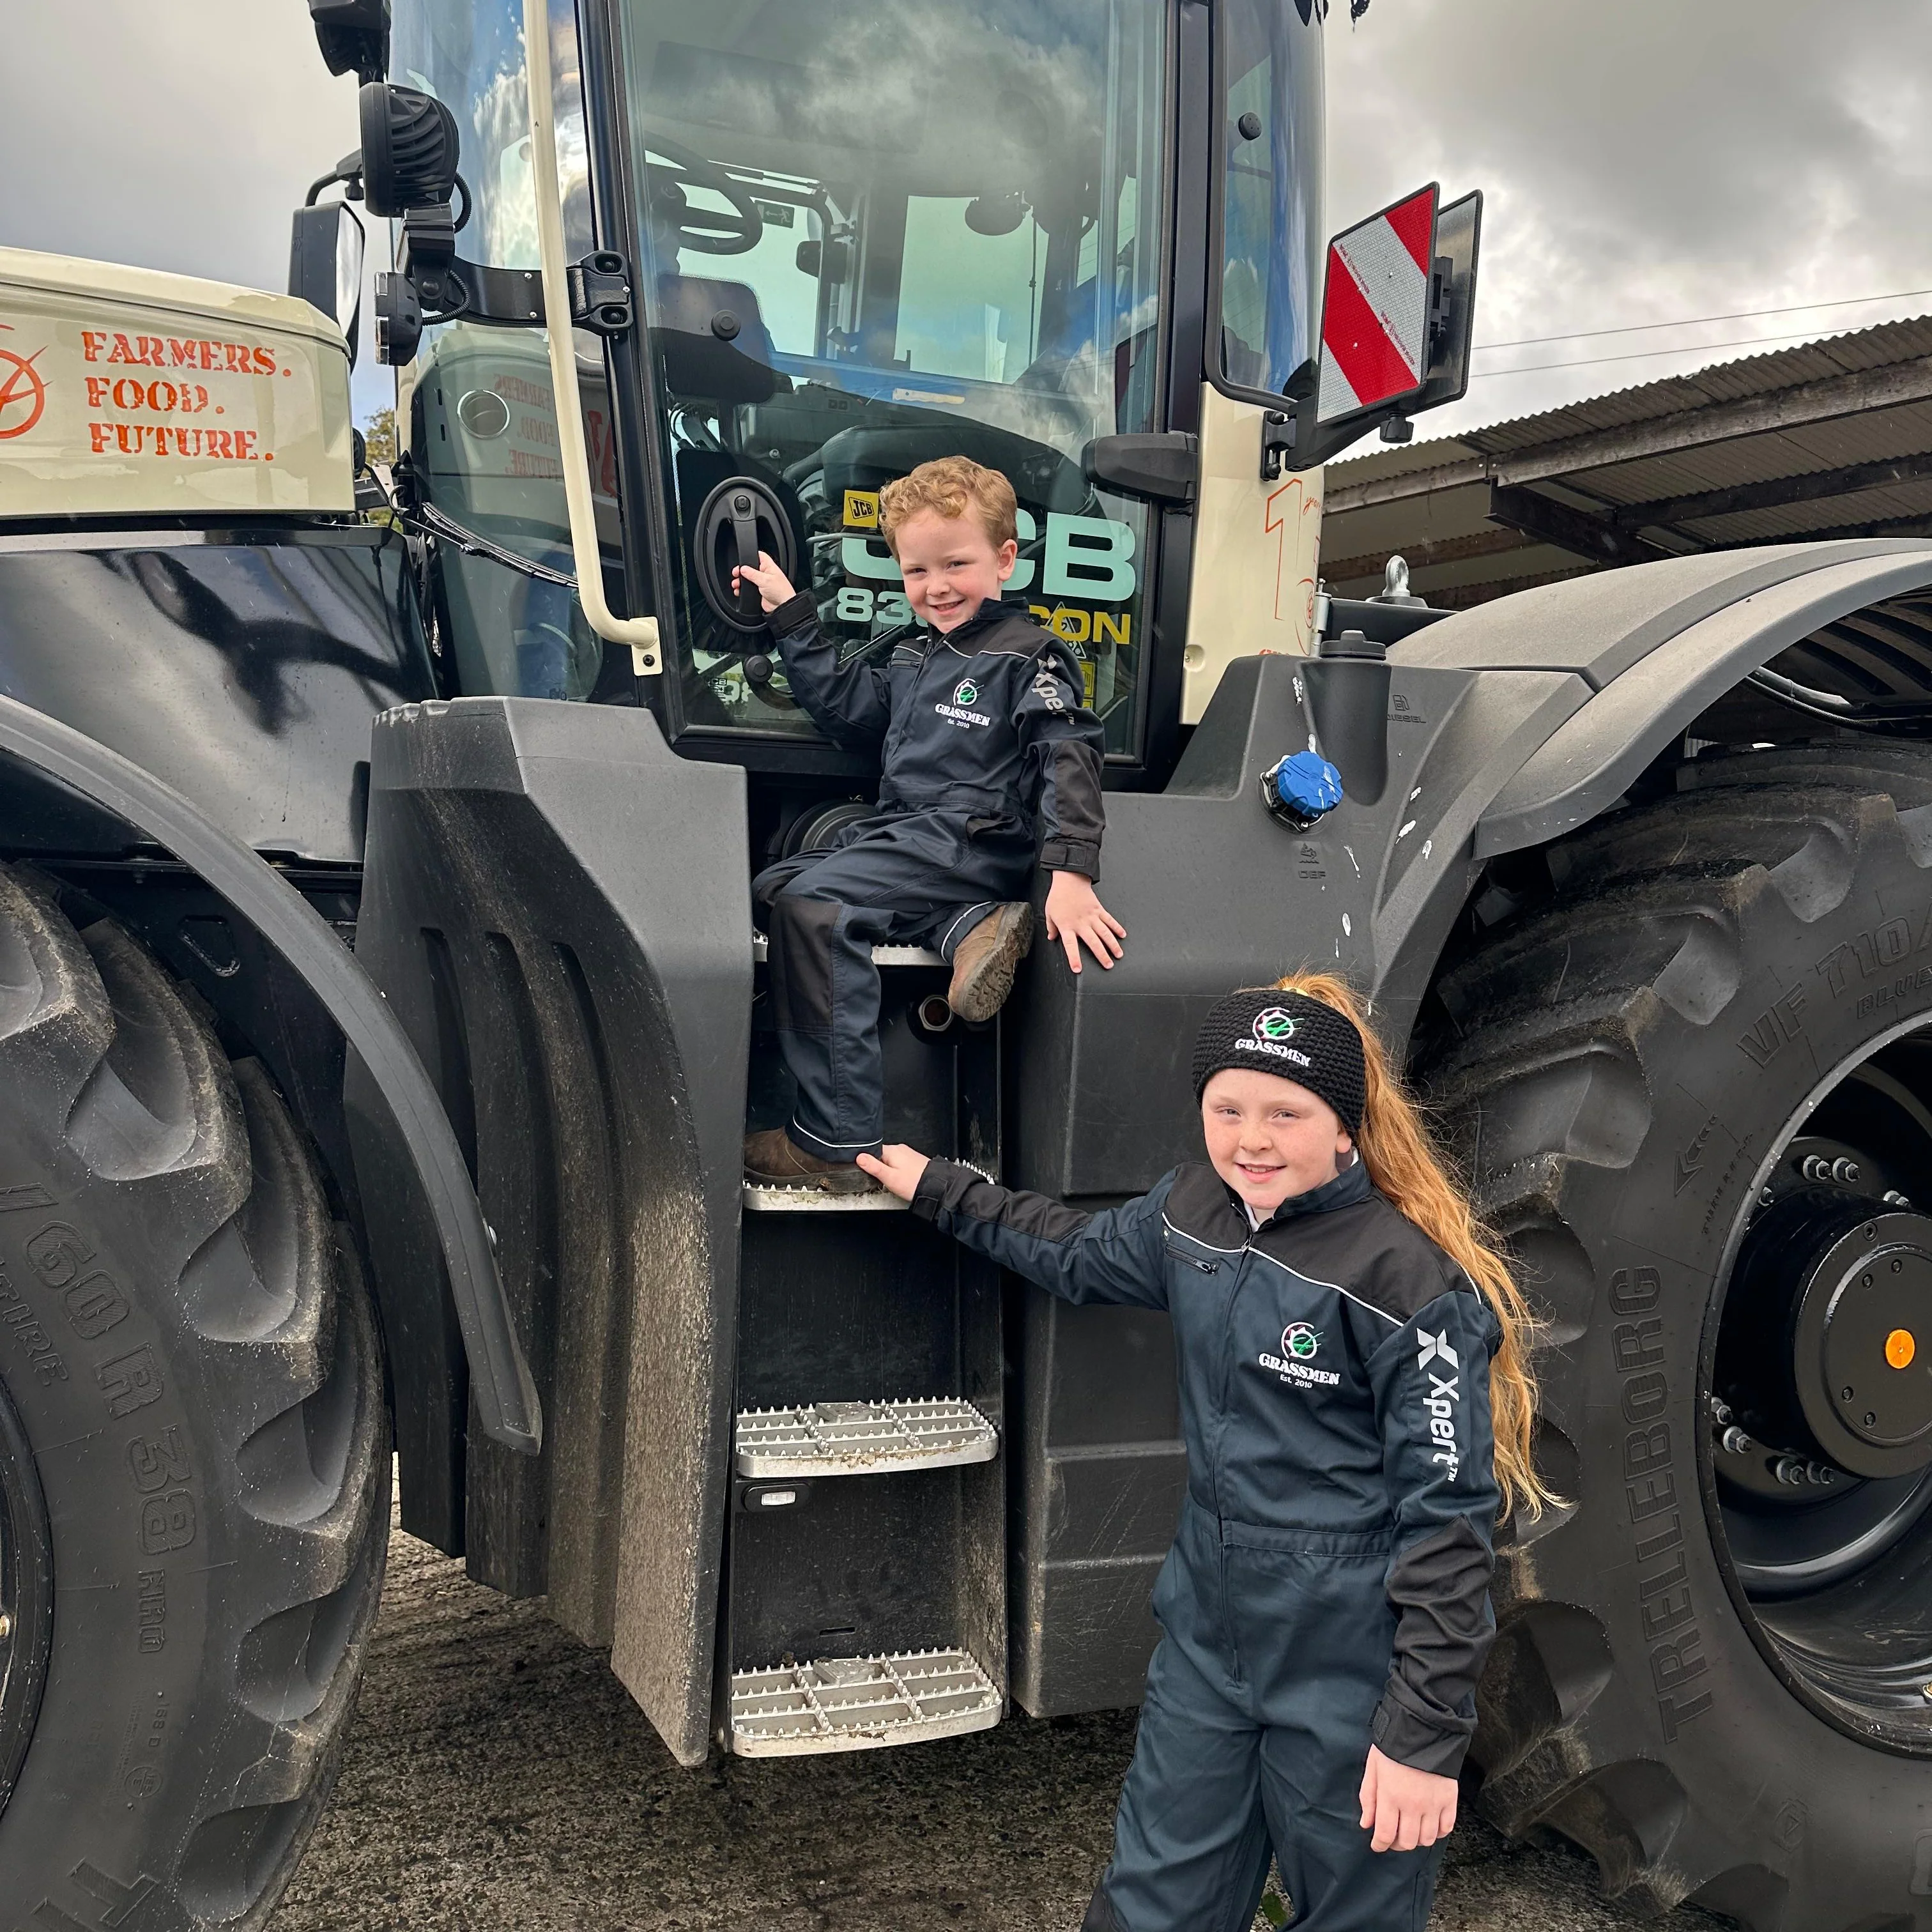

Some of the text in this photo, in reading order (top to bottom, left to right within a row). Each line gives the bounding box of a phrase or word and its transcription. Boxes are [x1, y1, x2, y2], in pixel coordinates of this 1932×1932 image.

[81, 330, 291, 377] FARMERS.
[85, 377, 224, 414] FOOD.
[88, 423, 274, 461] FUTURE.
[852, 498, 873, 518] JCB
[935, 703, 990, 726] GRASSMEN
[956, 721, 970, 729] 2010
[1298, 870, 1326, 879] DEF
[1235, 1038, 1311, 1067] GRASSMEN
[1259, 1352, 1340, 1385] GRASSMEN
[1280, 1374, 1312, 1388] Est. 2010
[127, 1424, 196, 1555] 38
[1607, 1265, 1713, 1745] TRELLEBORG
